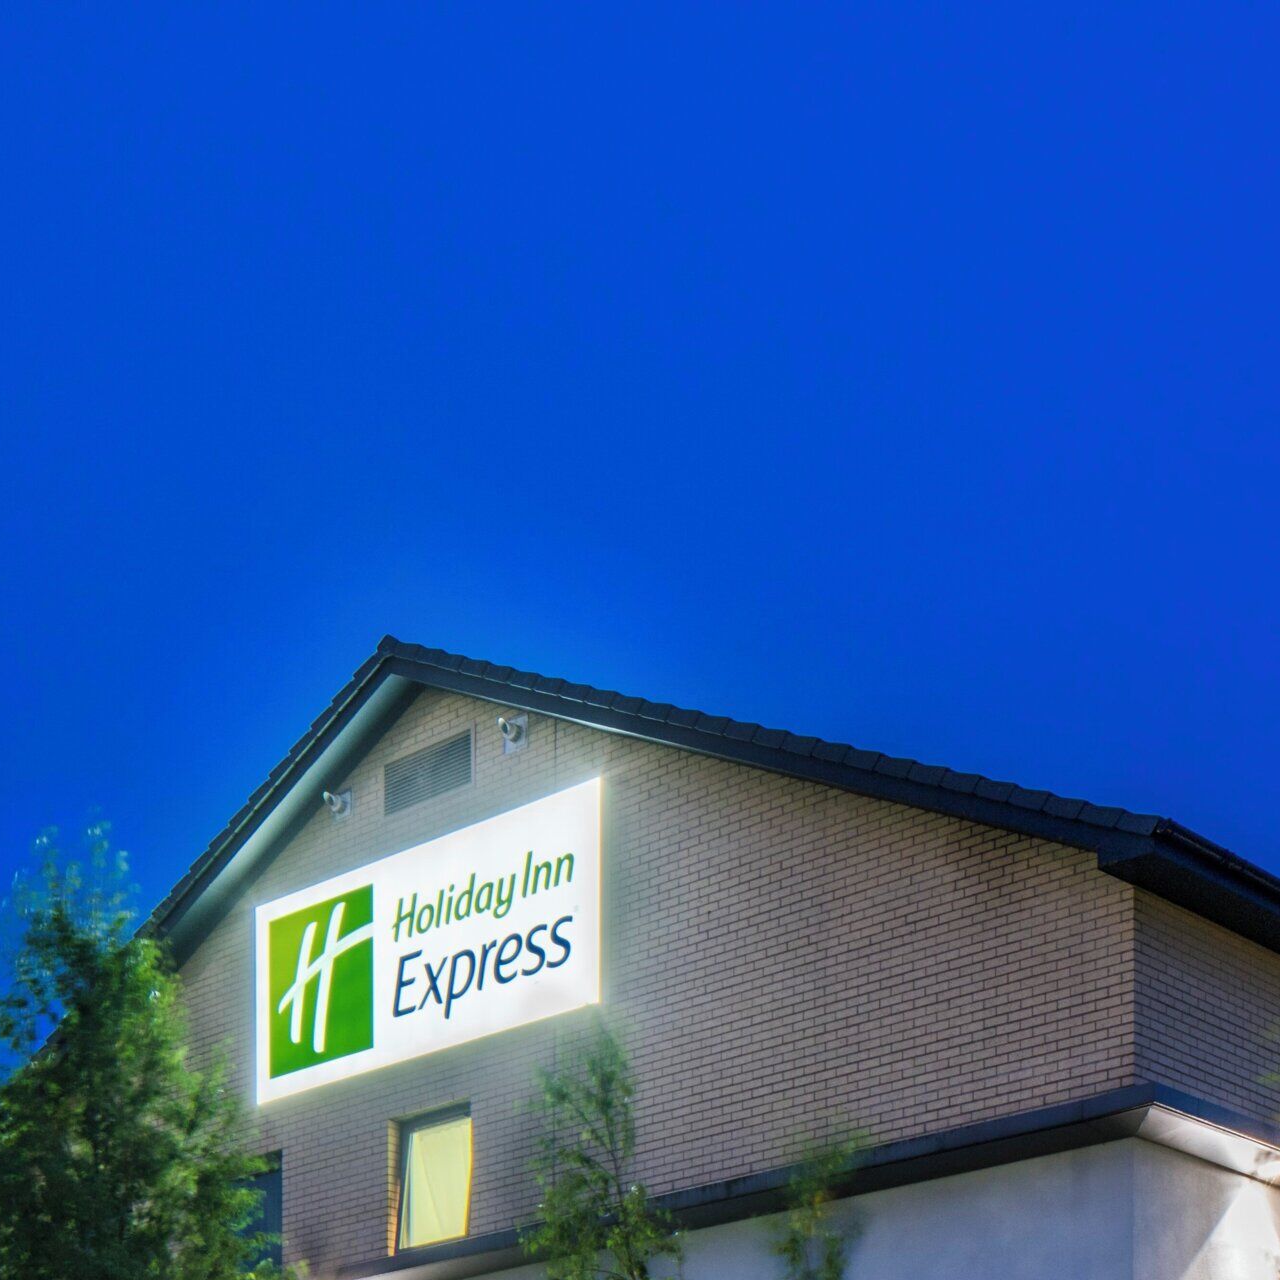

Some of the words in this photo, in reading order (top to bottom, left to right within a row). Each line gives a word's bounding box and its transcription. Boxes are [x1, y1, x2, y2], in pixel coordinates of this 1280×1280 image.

[392, 872, 516, 942] Holiday
[521, 850, 575, 899] Inn
[277, 901, 373, 1053] H
[392, 915, 574, 1020] Express
